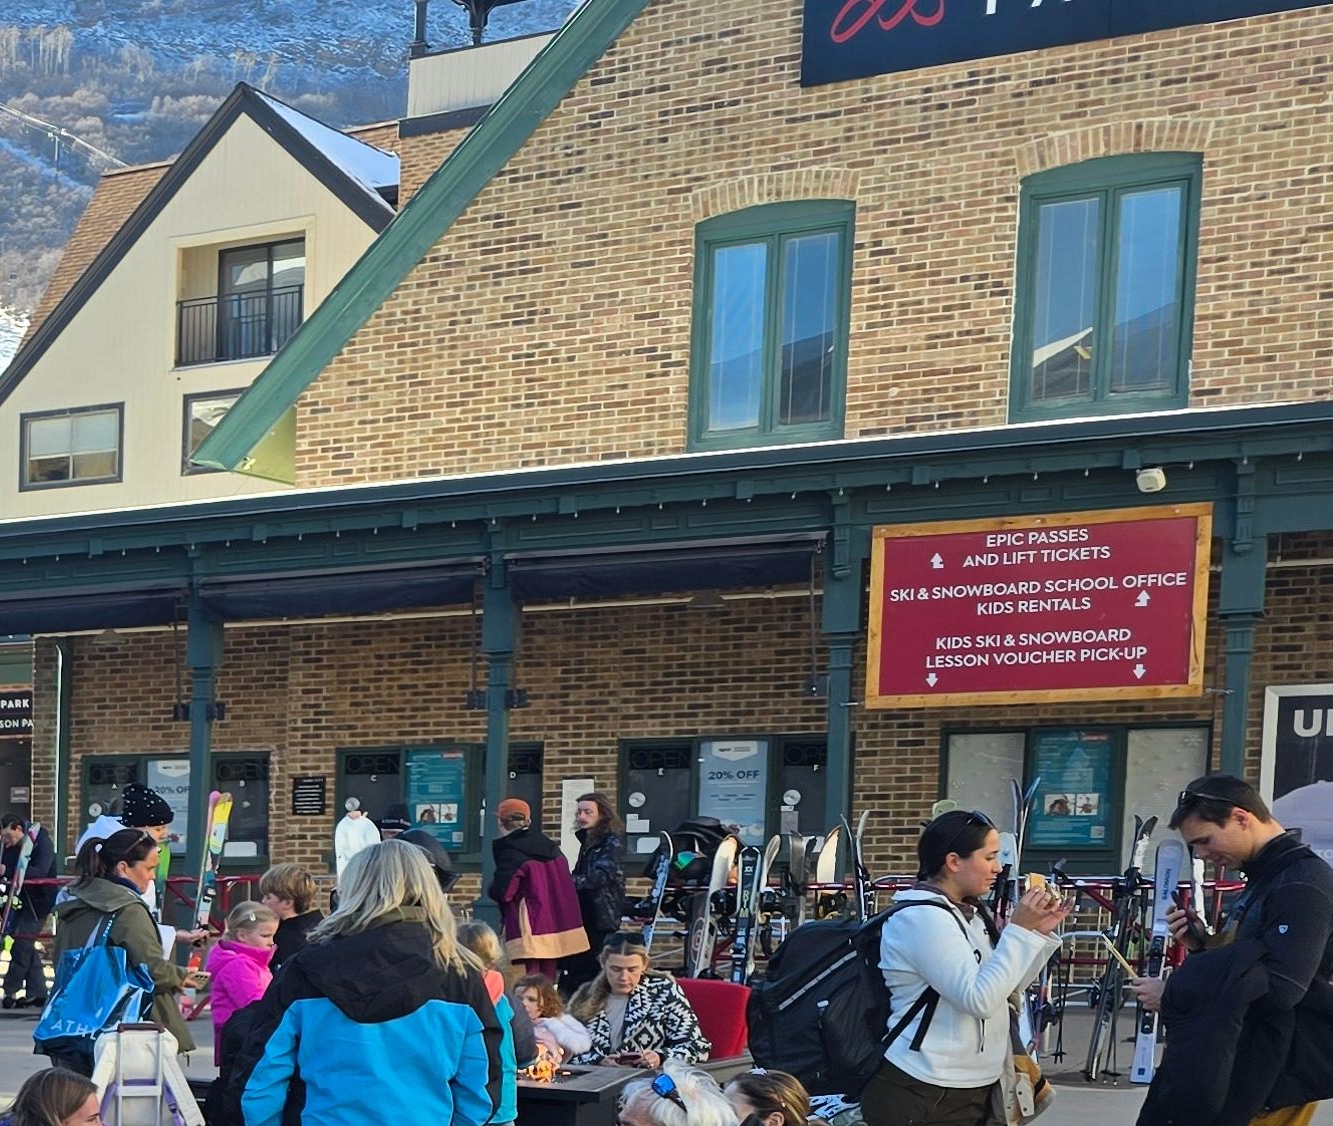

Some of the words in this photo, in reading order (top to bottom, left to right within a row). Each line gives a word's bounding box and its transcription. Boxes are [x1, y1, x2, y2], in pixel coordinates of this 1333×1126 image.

[986, 531, 1024, 547] EPIC
[1028, 528, 1089, 545] PASSES
[962, 552, 999, 568] AND
[1003, 551, 1037, 566] LIFT
[1040, 546, 1110, 562] TICKETS
[890, 588, 915, 602] SKI
[917, 588, 929, 600] &
[932, 581, 1042, 600] SNOWBOARD
[1044, 576, 1119, 593] SCHOOL
[1122, 572, 1187, 588] OFFICE
[977, 601, 1015, 615] KIDS
[1018, 597, 1092, 613] RENTALS
[936, 636, 973, 650] KIDS
[975, 634, 1001, 648] SKI
[1004, 633, 1016, 646] &
[1019, 628, 1132, 646] SNOWBOARD
[925, 653, 989, 669] LESSON
[994, 650, 1076, 666] VOUCHER
[1080, 646, 1148, 662] PICK-UP
[0, 698, 30, 709] PARK
[21, 718, 35, 730] PA
[508, 755, 543, 773] PEN
[708, 770, 734, 781] 20%
[736, 770, 760, 780] OFF
[176, 785, 190, 795] OF
[50, 1018, 97, 1041] ATHL
